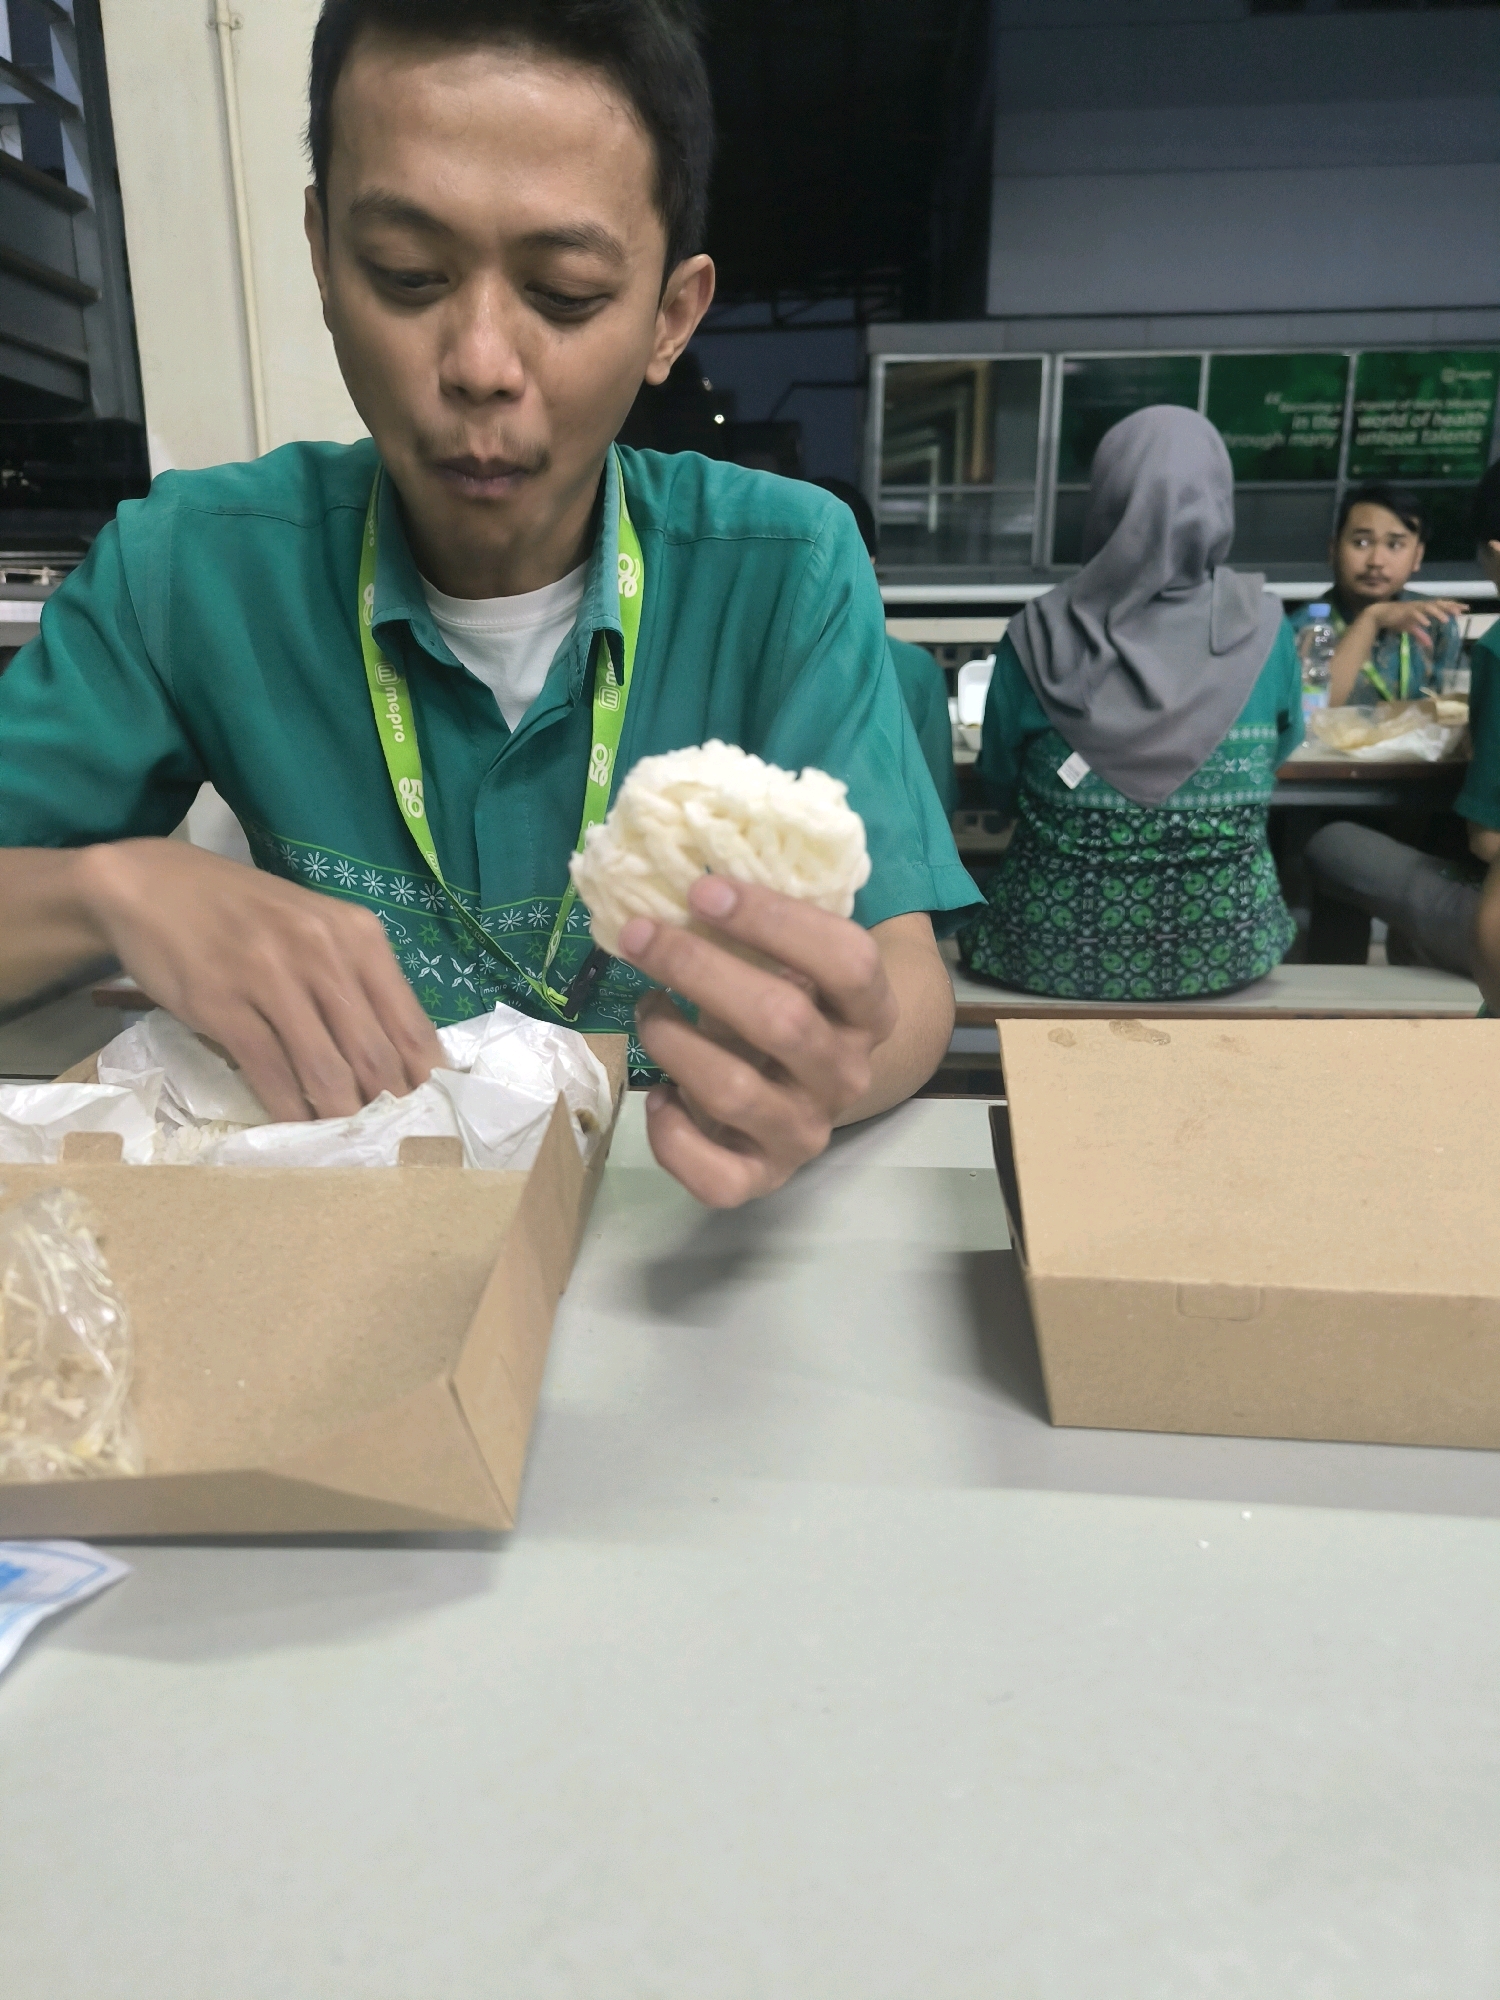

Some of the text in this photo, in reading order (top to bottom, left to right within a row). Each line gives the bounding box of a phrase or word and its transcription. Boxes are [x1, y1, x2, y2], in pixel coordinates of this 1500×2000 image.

[1288, 433, 1338, 449] many
[1356, 431, 1417, 446] unique
[1421, 429, 1481, 444] talents
[1312, 414, 1340, 430] the
[1358, 413, 1408, 428] world
[1410, 411, 1431, 428] of
[1433, 411, 1487, 427] health
[385, 687, 406, 743] mepro
[588, 743, 611, 787] 50
[399, 777, 425, 819] 50
